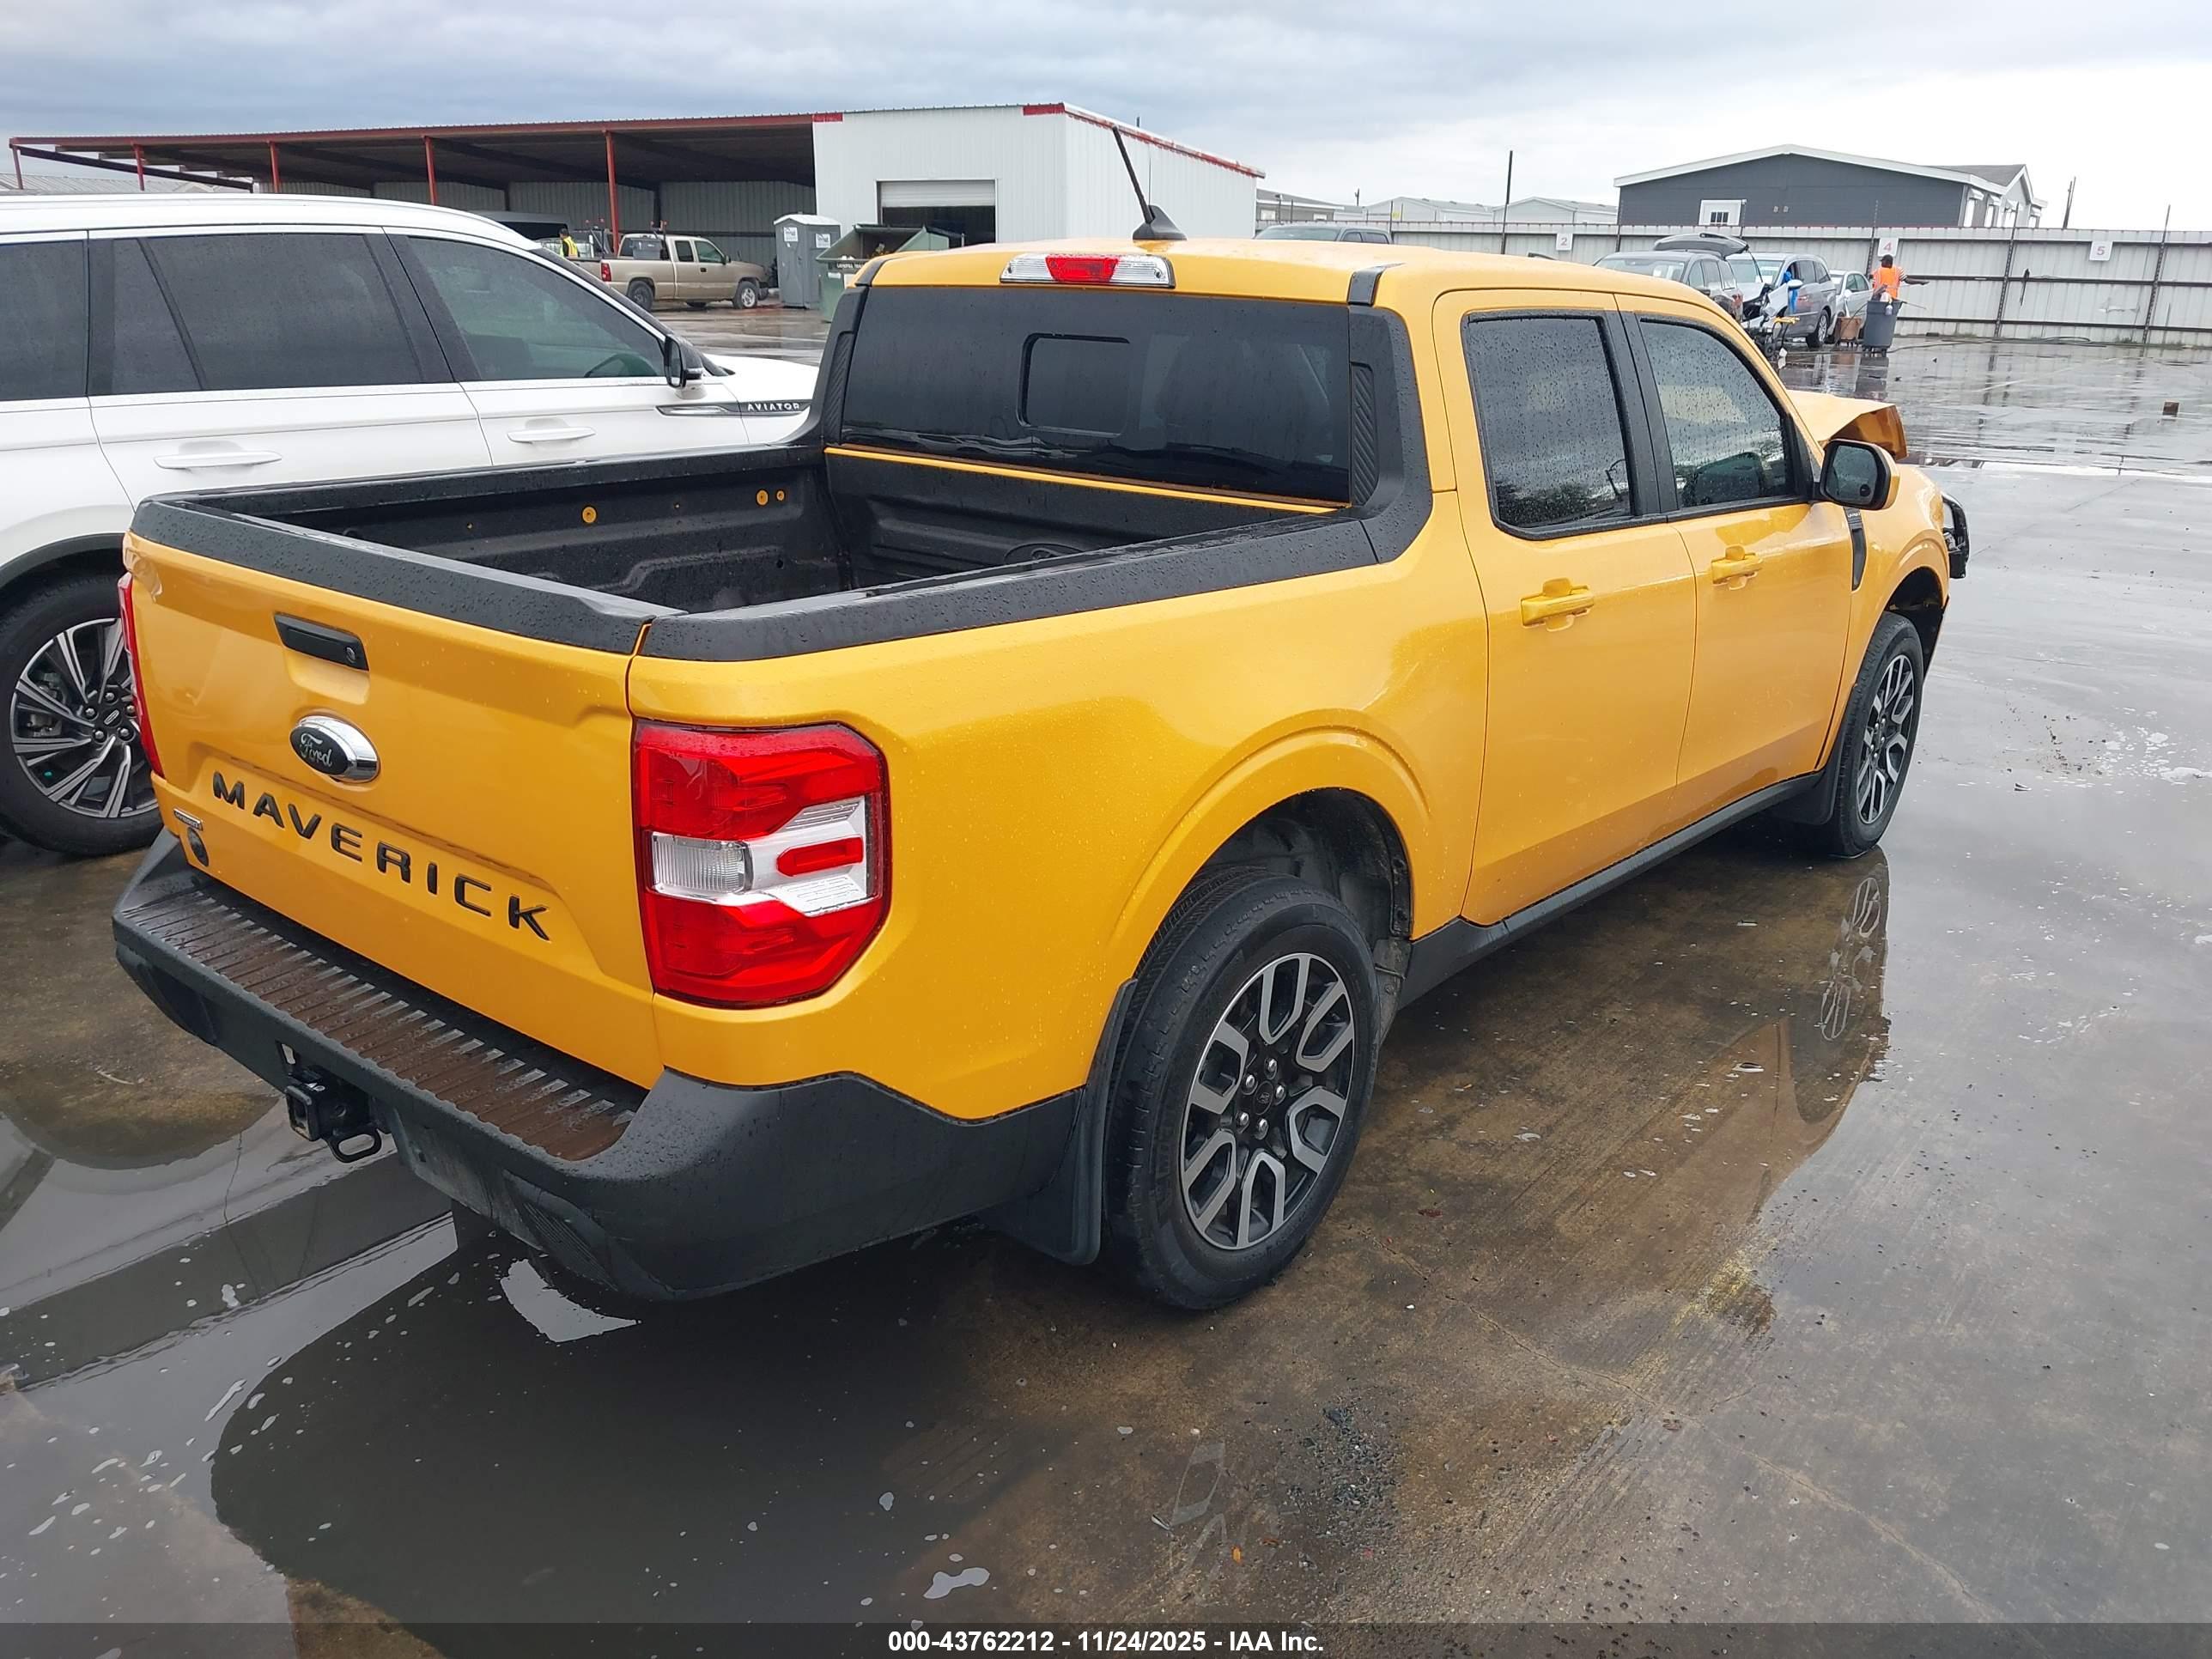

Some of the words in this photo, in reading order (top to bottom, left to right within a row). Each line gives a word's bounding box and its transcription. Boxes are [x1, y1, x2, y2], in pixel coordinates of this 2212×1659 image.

[1559, 237, 1567, 246] 2
[1883, 241, 1892, 252] 4
[2096, 245, 2106, 255] 5
[747, 402, 800, 412] AVIATOR
[300, 732, 333, 768] Ford
[212, 770, 550, 942] MAVERICK
